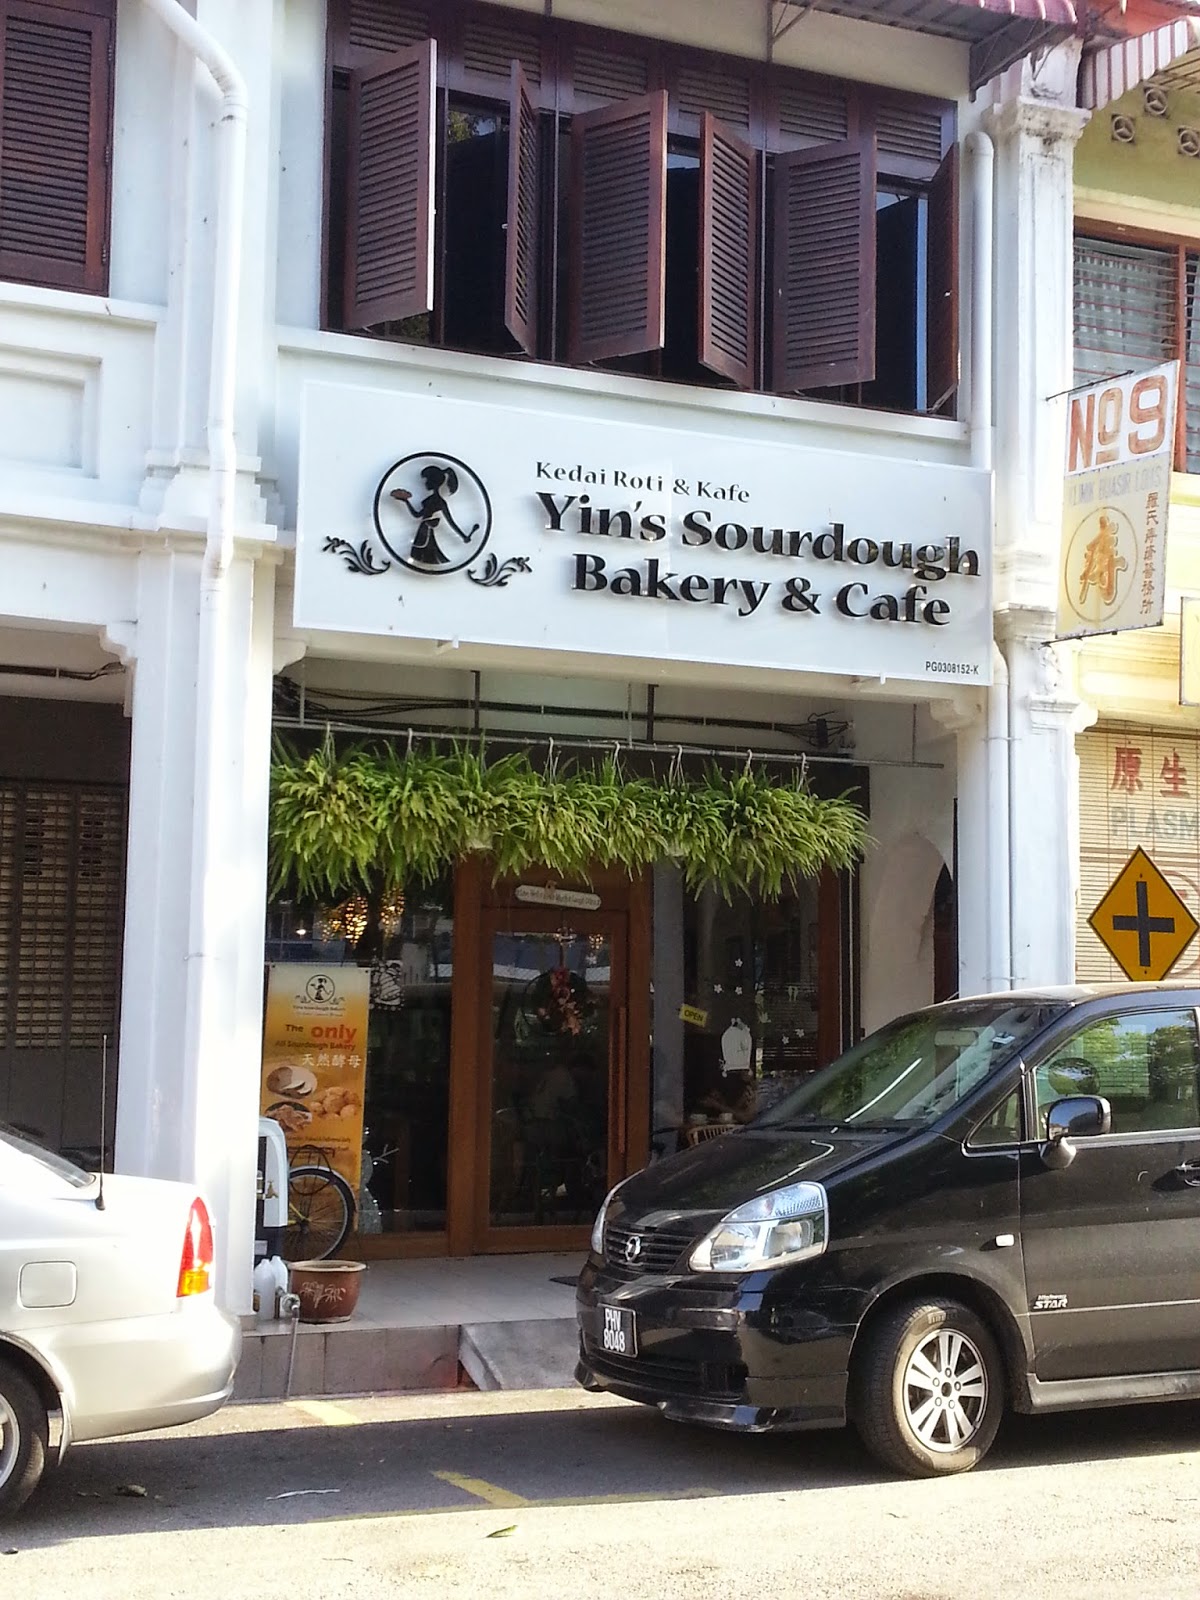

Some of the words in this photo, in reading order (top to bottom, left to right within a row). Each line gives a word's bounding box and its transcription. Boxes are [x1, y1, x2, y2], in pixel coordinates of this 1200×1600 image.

[536, 461, 607, 486] Kedai
[613, 470, 664, 493] Roti
[673, 477, 692, 496] &
[697, 481, 751, 504] Kafe
[535, 491, 667, 542] Yin's
[681, 510, 982, 583] Sourdough
[571, 553, 772, 618] Bakery
[781, 576, 823, 616] &
[834, 582, 952, 627] Cafe
[925, 660, 980, 676] PG0308152-K
[684, 1009, 704, 1022] OPEN
[285, 1024, 304, 1033] The
[311, 1024, 357, 1044] only
[287, 1040, 329, 1051] Sourdough
[329, 1042, 356, 1052] Bakery
[301, 1052, 363, 1069] 天然酵母
[1033, 1299, 1068, 1310] STAR
[603, 1328, 626, 1352] 8048
